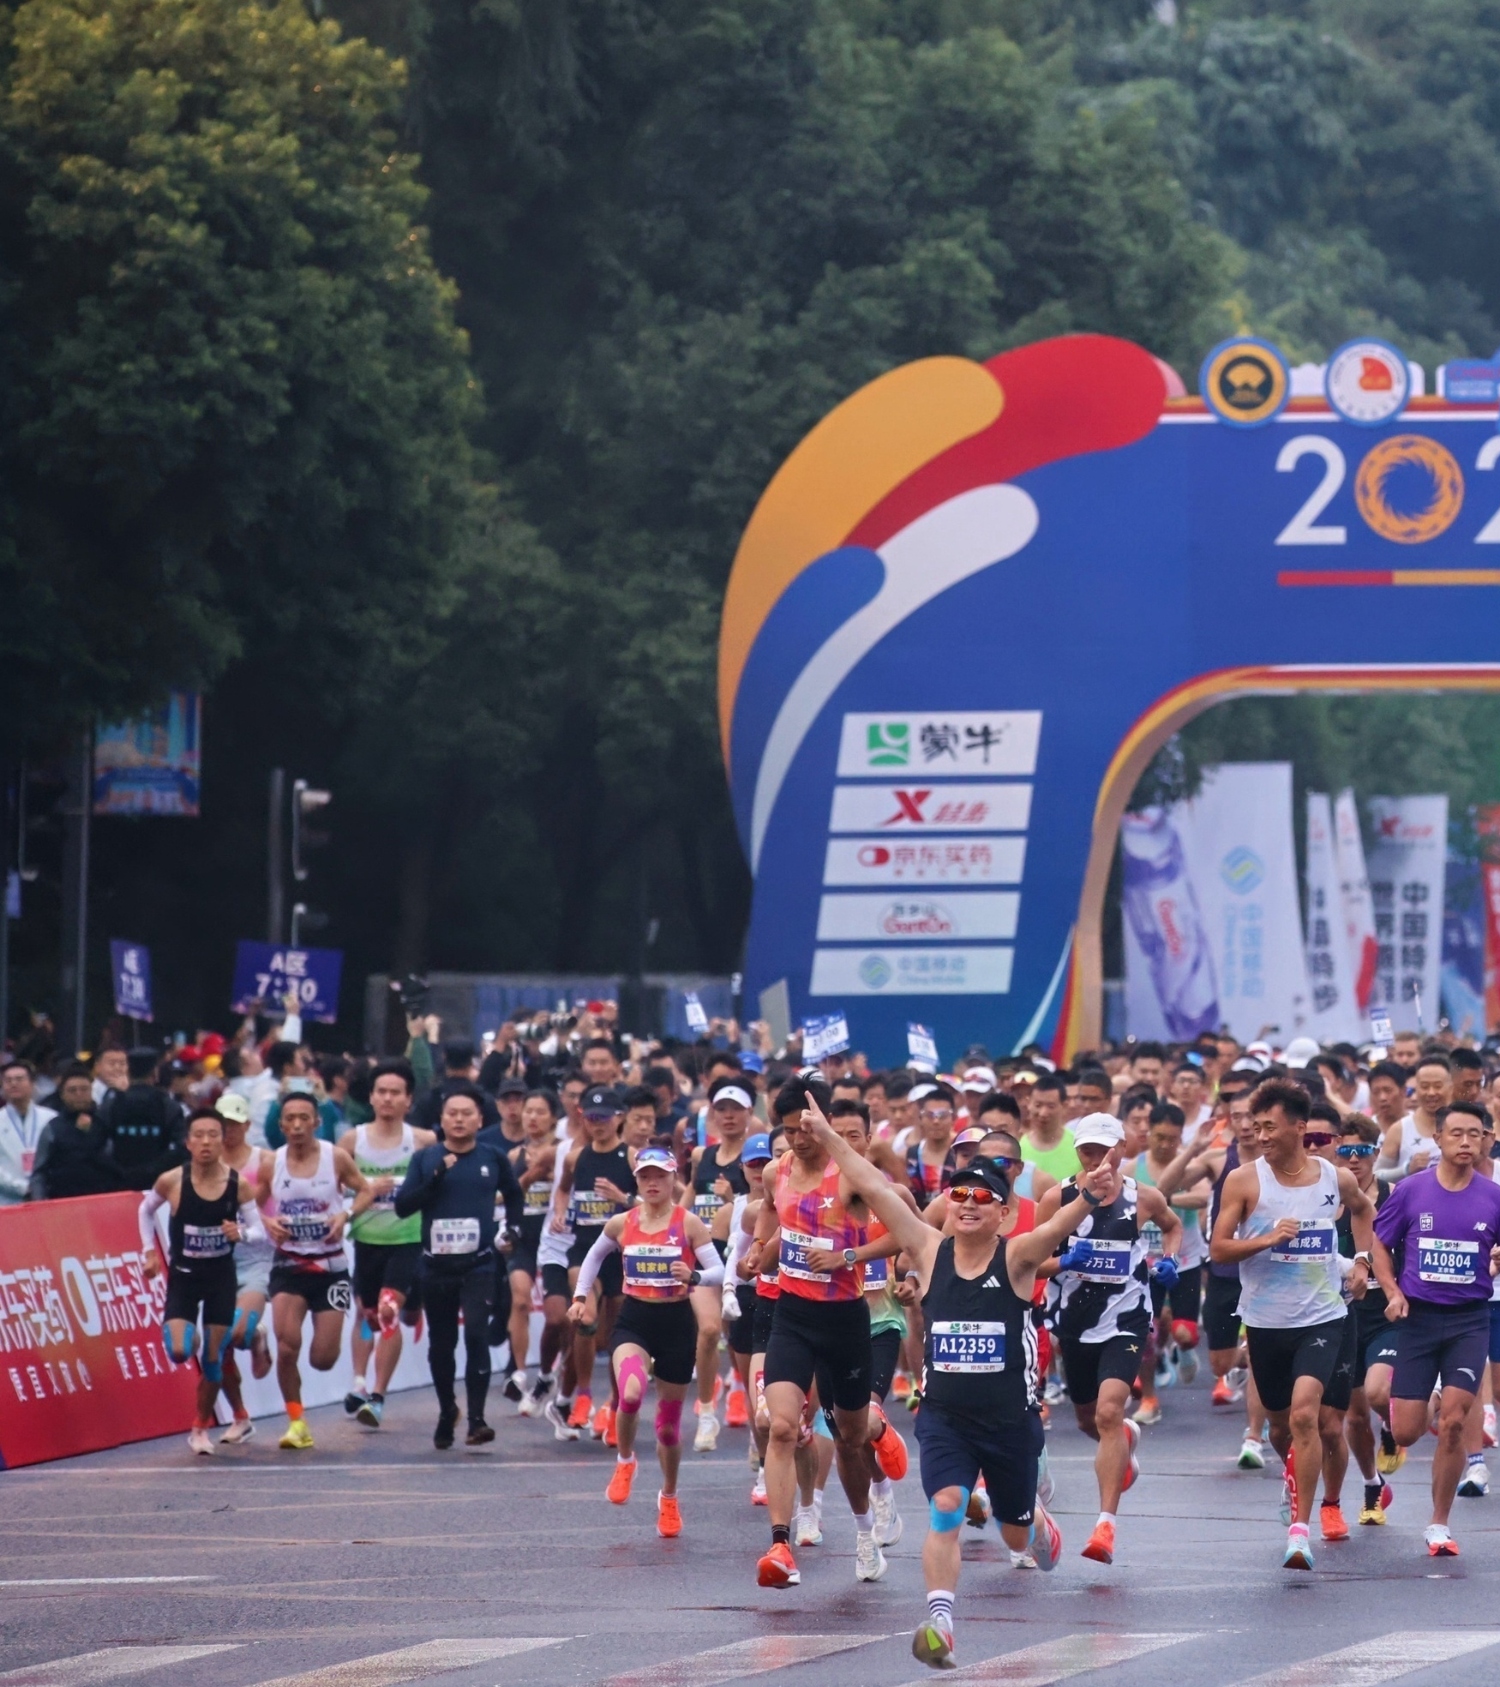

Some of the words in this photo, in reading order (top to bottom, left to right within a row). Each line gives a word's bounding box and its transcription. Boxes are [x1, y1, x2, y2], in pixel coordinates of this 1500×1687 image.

[920, 724, 1003, 765] 蒙牛
[1402, 882, 1429, 1002] 中国特步
[1302, 1220, 1318, 1229] 蒙牛
[798, 1233, 814, 1246] 蒙牛
[1094, 1240, 1113, 1251] 蒙牛
[1288, 1236, 1322, 1249] 高成亮
[1444, 1241, 1461, 1250] 蒙牛
[1423, 1251, 1472, 1268] A10804
[961, 1323, 982, 1335] 蒙牛
[939, 1337, 997, 1354] A12359
